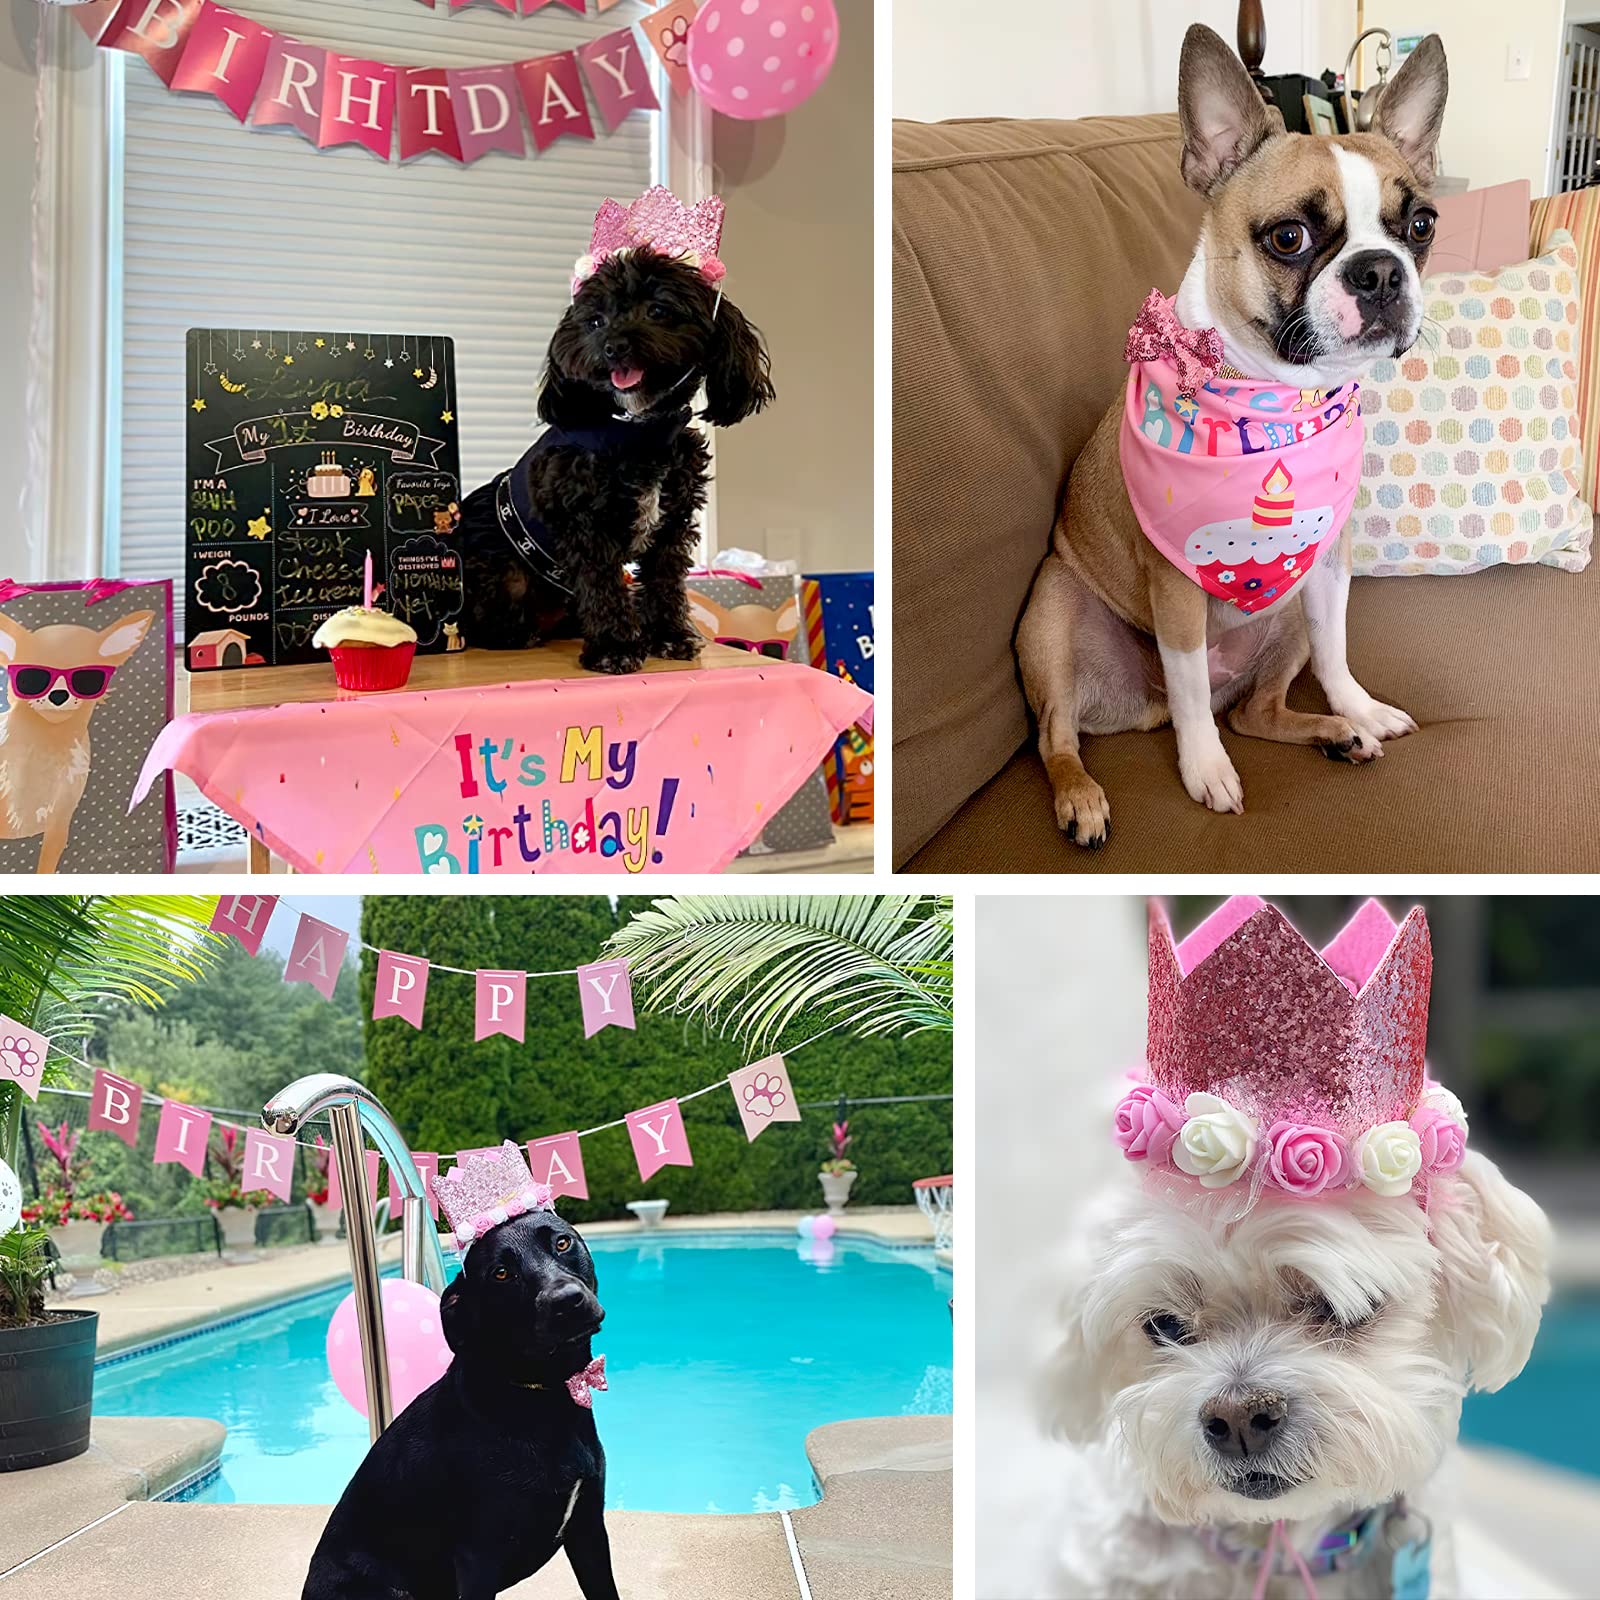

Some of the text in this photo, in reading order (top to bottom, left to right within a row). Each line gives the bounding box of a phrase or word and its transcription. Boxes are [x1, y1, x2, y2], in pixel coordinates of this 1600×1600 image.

[242, 426, 270, 447] My
[343, 418, 414, 450] Birthday
[193, 478, 228, 490] I'M A
[396, 478, 431, 490] Favorite
[307, 508, 351, 524] I Love
[198, 550, 231, 560] WEIGH
[398, 563, 440, 571] DESTROYED
[216, 573, 238, 601] 8
[228, 613, 270, 623] POUNDS
[454, 725, 638, 798] It's My
[223, 895, 621, 1022] HAPPY
